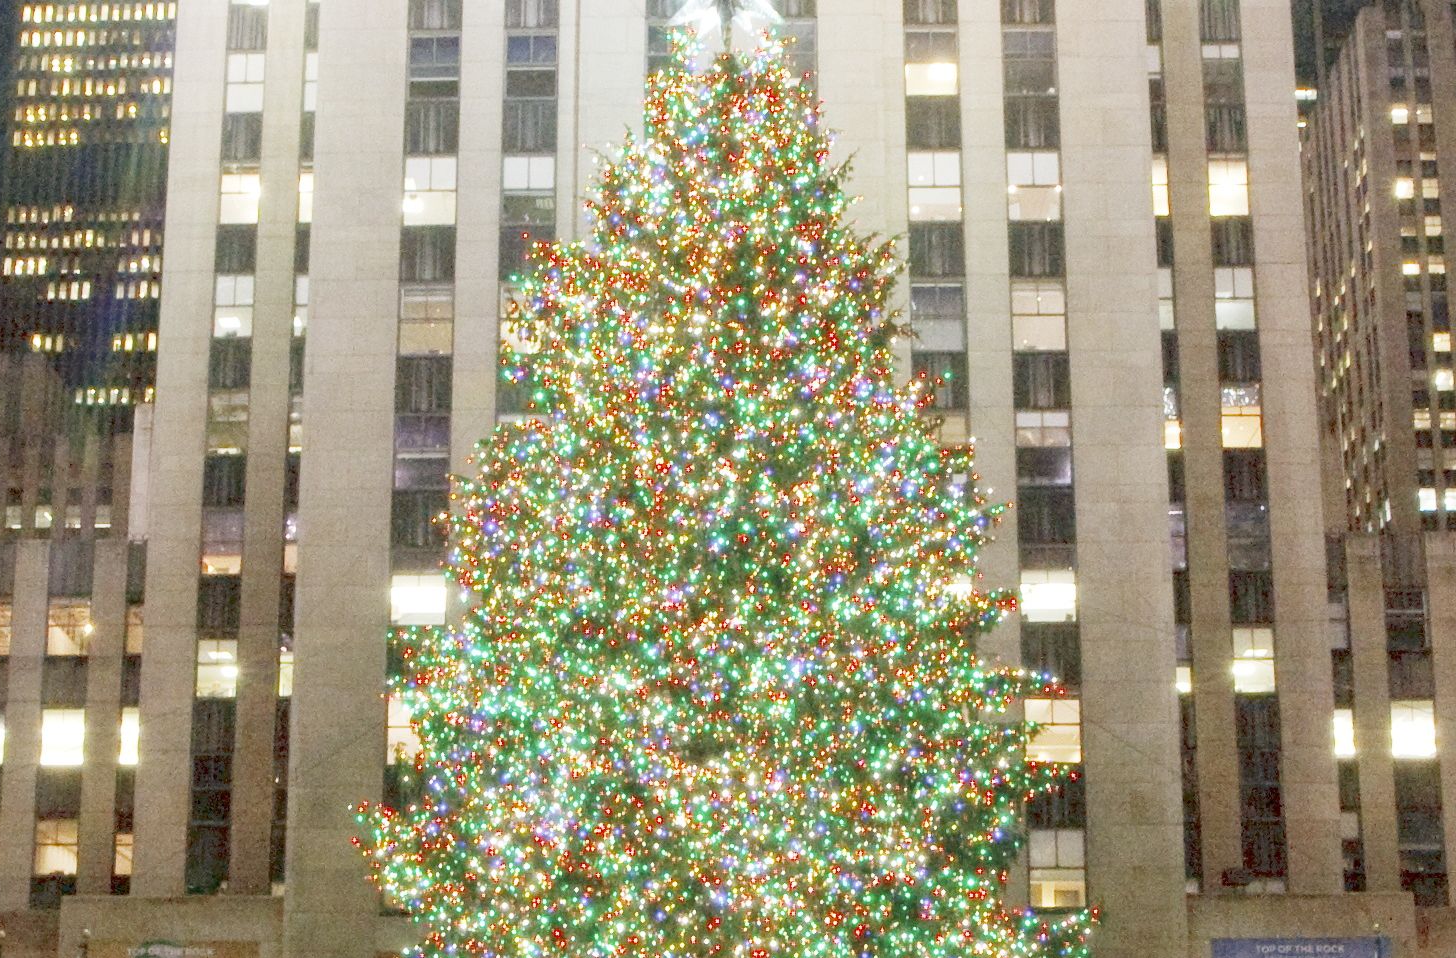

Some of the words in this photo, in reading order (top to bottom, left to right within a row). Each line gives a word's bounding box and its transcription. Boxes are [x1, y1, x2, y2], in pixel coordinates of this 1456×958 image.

[1256, 945, 1276, 954] TOP
[1278, 944, 1292, 954] OF
[1296, 944, 1313, 953] THE
[1316, 944, 1345, 954] ROCK
